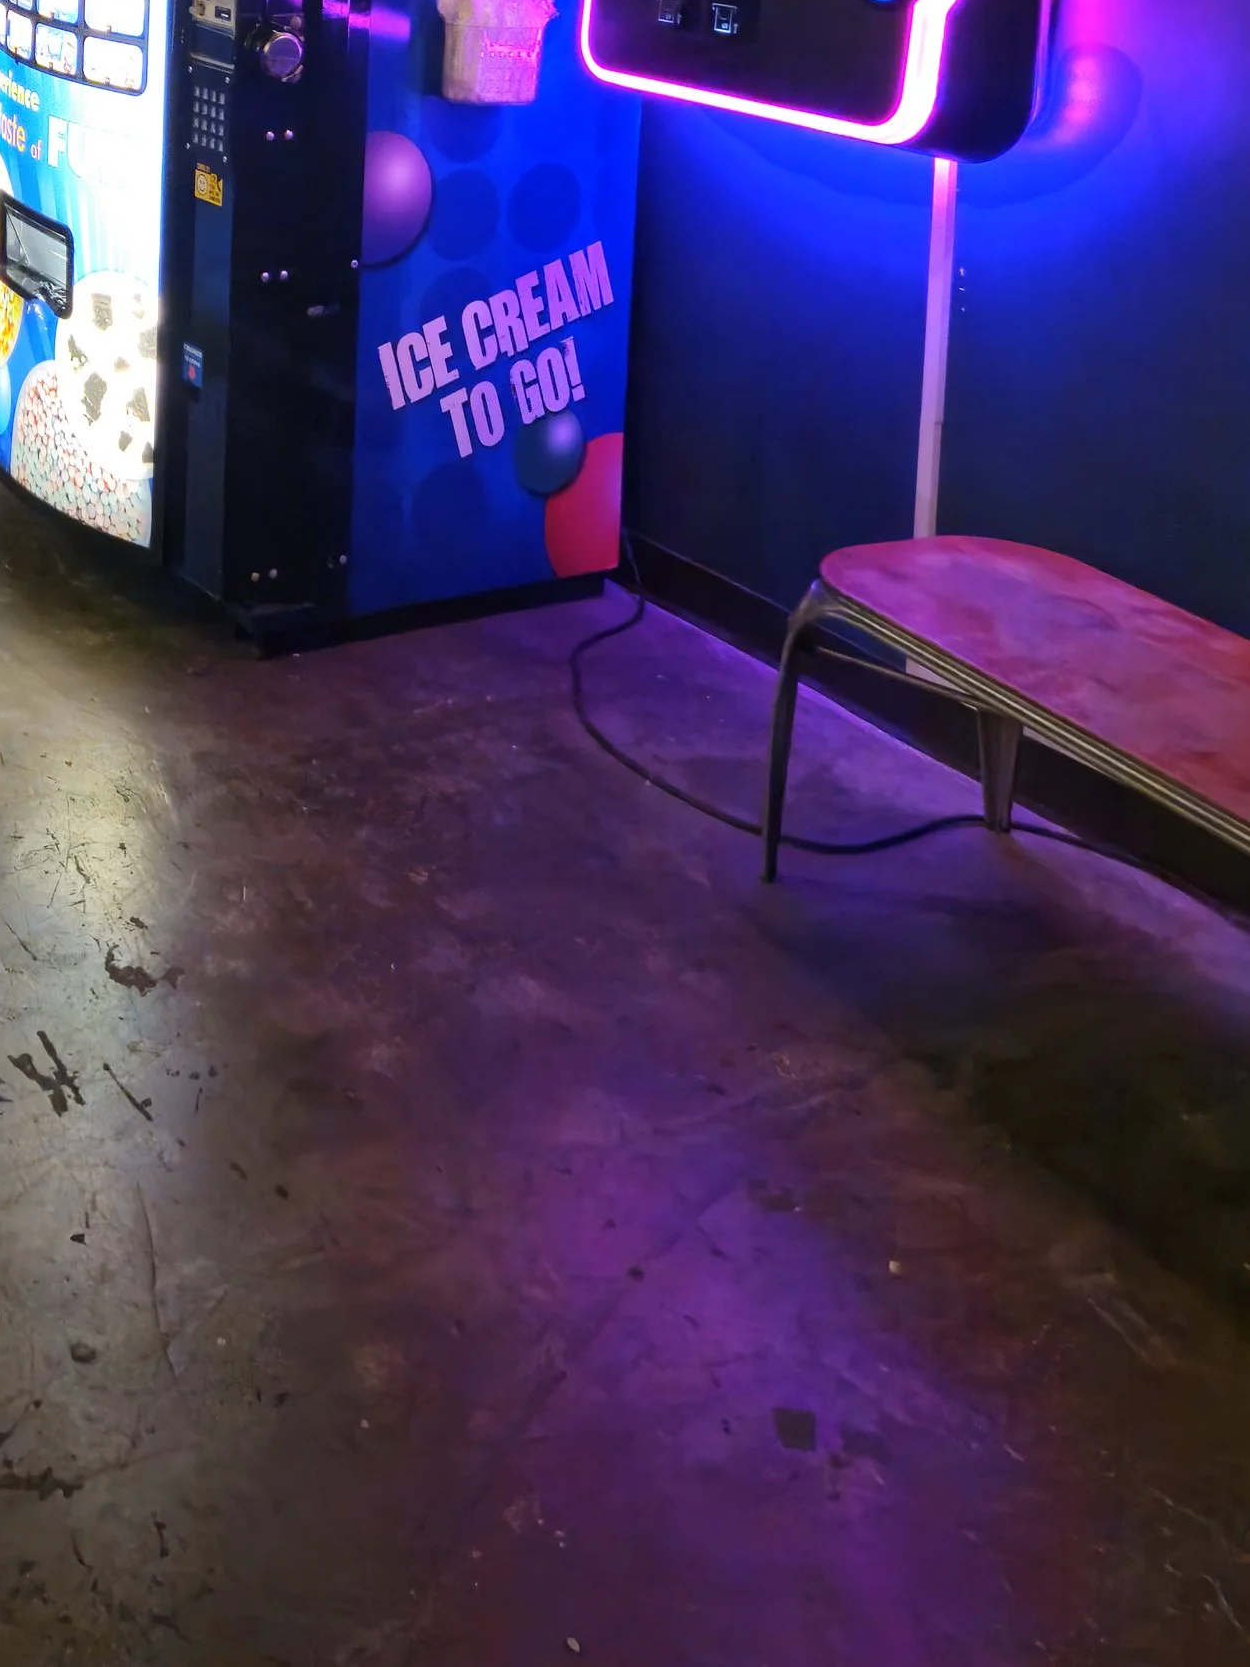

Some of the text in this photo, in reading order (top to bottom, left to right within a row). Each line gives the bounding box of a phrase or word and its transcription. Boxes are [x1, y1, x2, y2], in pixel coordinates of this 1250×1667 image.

[30, 139, 43, 161] of
[377, 240, 614, 410] ICE CREAM
[439, 335, 586, 458] TO GO!
